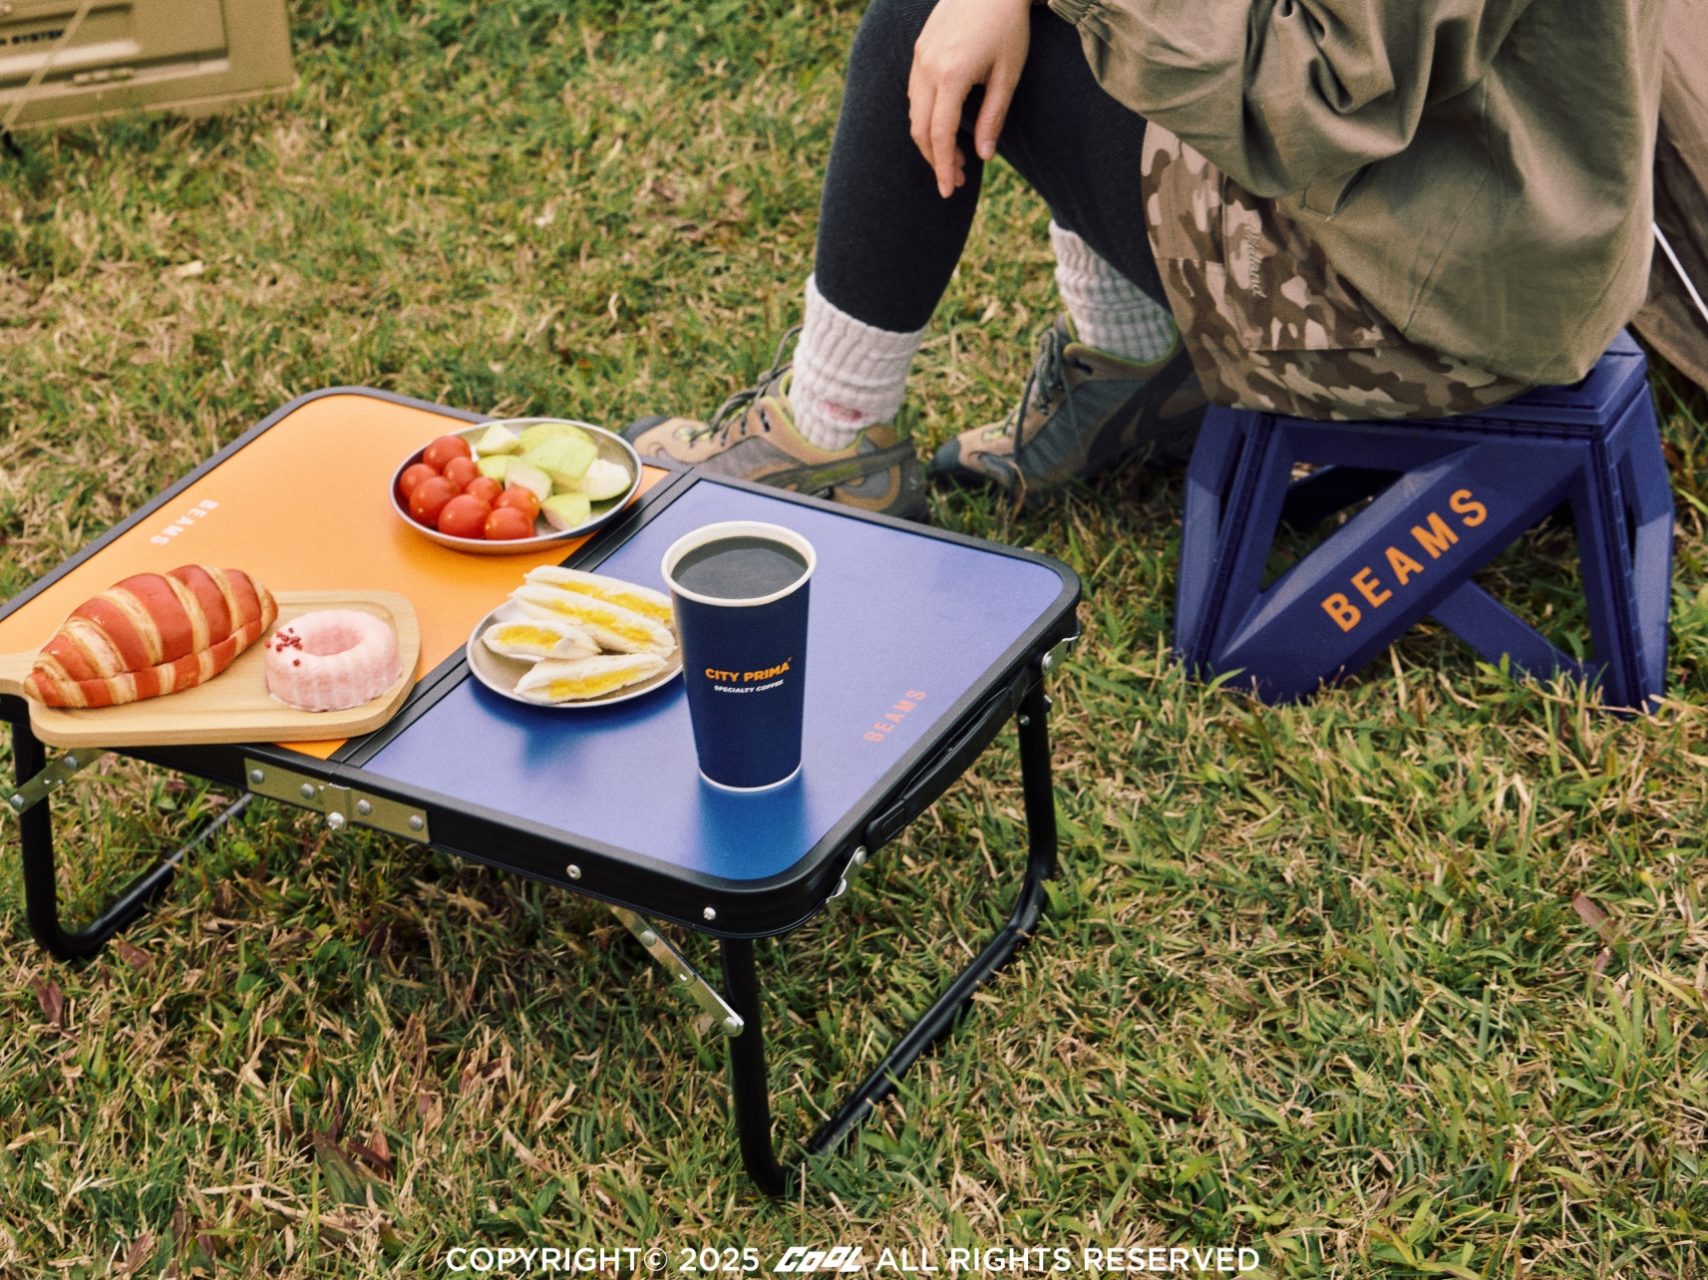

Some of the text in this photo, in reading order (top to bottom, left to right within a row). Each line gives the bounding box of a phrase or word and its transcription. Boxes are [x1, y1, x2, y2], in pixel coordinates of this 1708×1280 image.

[149, 499, 220, 545] BEAMS
[1320, 488, 1488, 633] BEAMS
[705, 662, 790, 682] CITY PRIMA
[713, 679, 784, 694] SPECIALTY COFFEE
[863, 689, 927, 743] BEAMS
